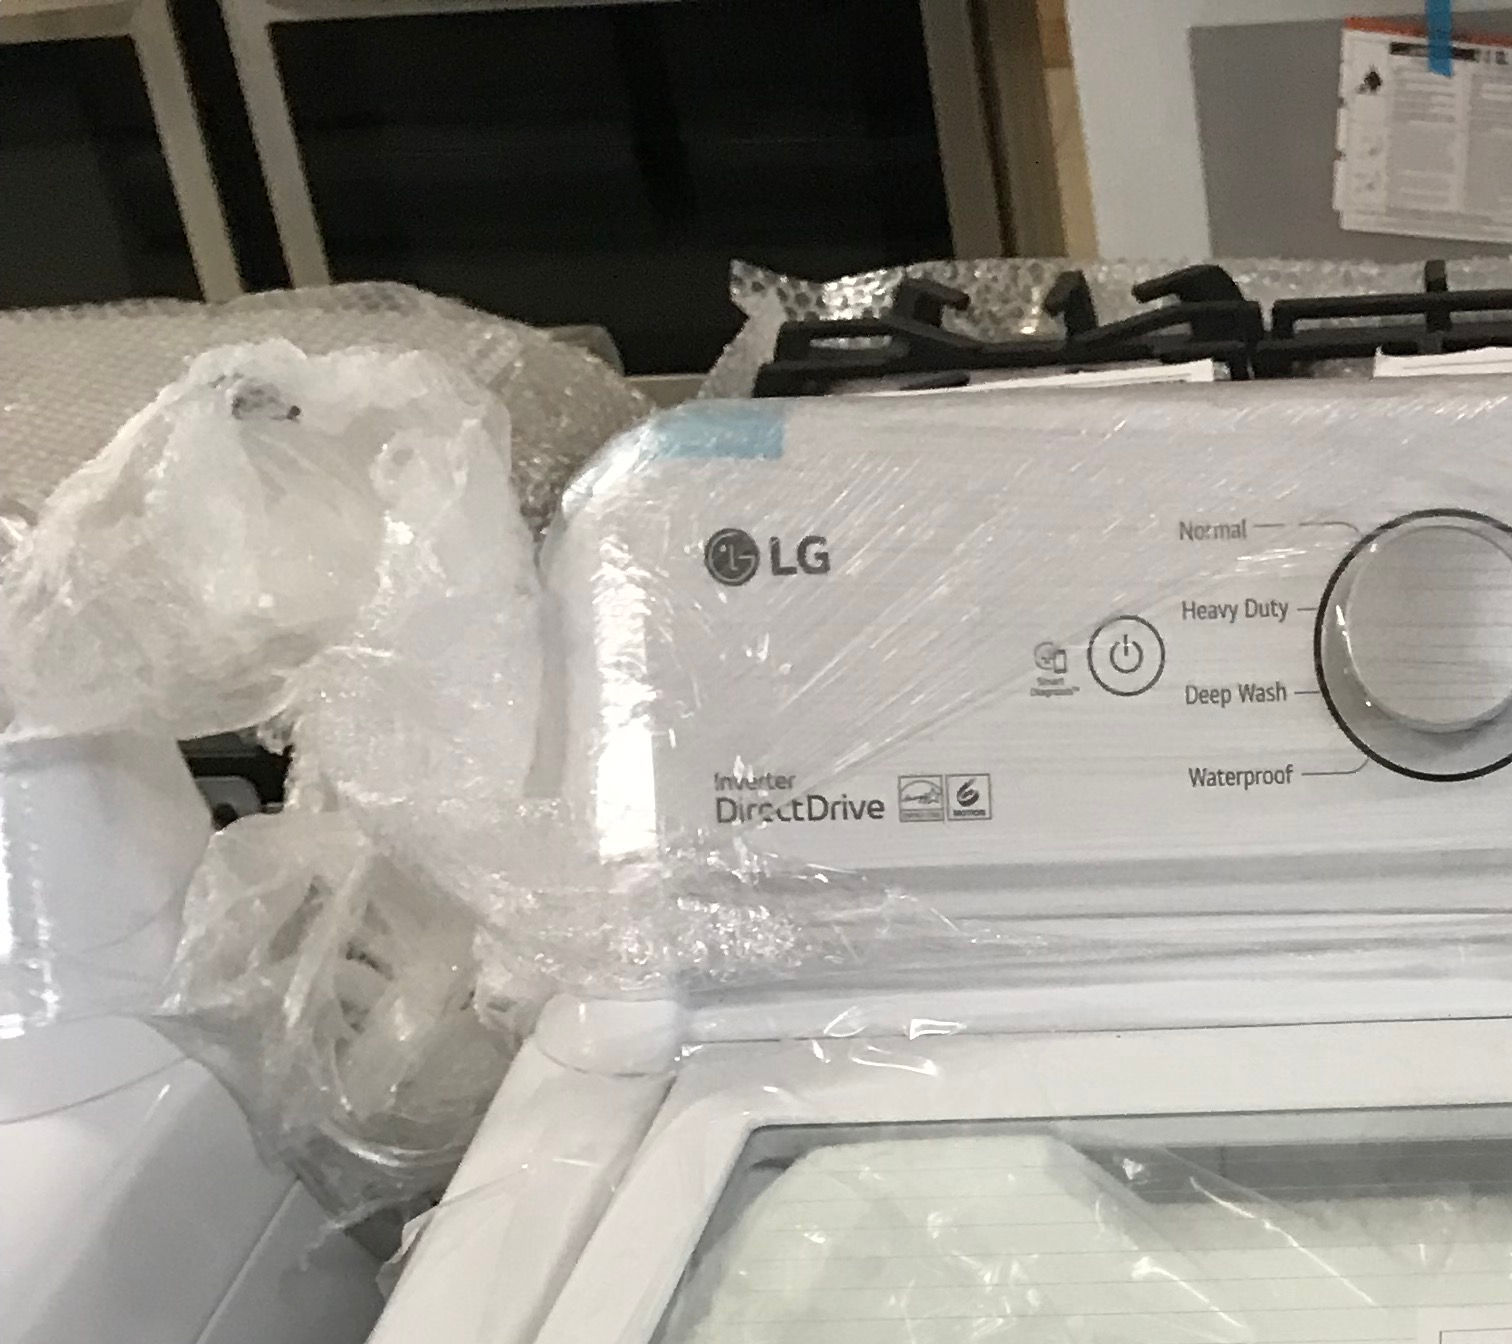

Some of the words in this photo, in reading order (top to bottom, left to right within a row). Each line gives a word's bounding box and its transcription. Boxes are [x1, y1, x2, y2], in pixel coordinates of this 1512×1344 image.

[1179, 518, 1247, 541] Normal
[769, 535, 831, 576] LG
[1182, 600, 1239, 623] Heavy
[1245, 598, 1289, 622] Duty
[1185, 684, 1232, 708] Deep
[1238, 681, 1287, 703] Wash
[714, 772, 796, 791] Inverter
[1188, 763, 1294, 791] Waterproof
[716, 793, 886, 824] DirectDrive
